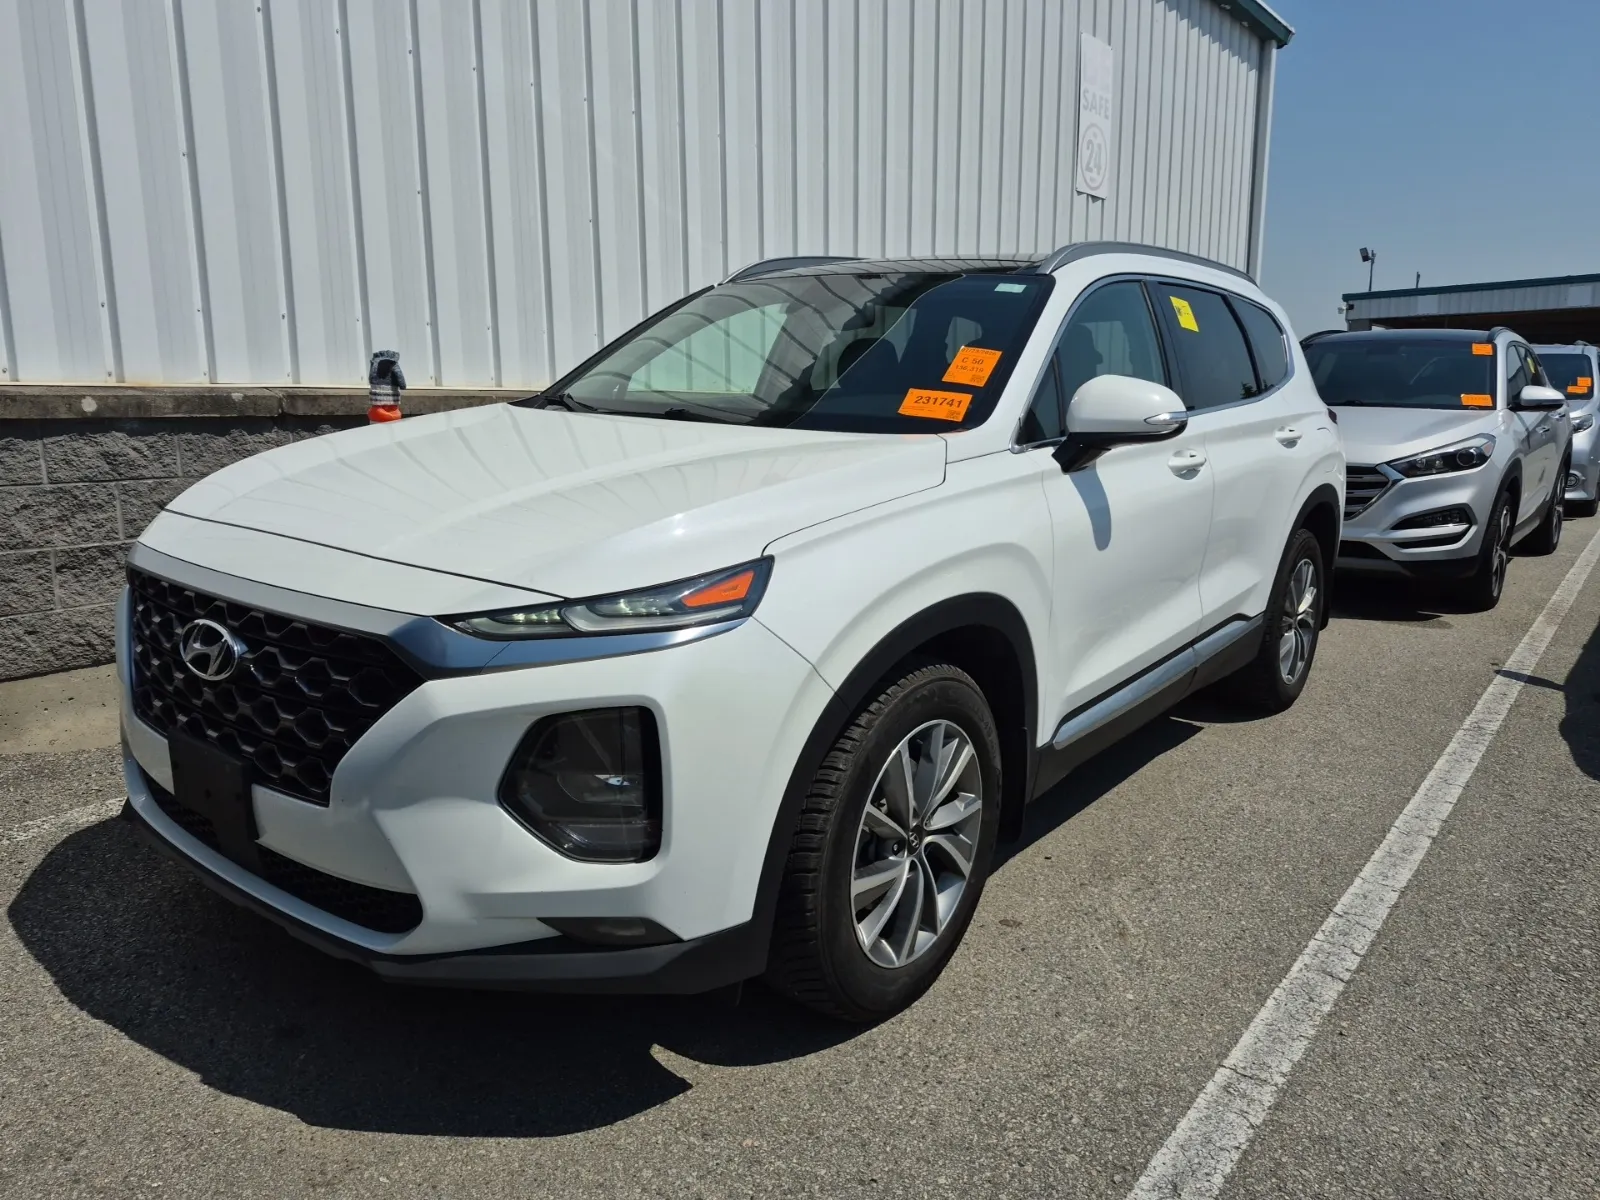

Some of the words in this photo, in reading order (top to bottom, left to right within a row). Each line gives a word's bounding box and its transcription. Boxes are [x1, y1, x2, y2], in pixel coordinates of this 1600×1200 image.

[1082, 87, 1110, 120] SAFE
[1085, 139, 1102, 176] 24
[914, 396, 962, 408] 231741
